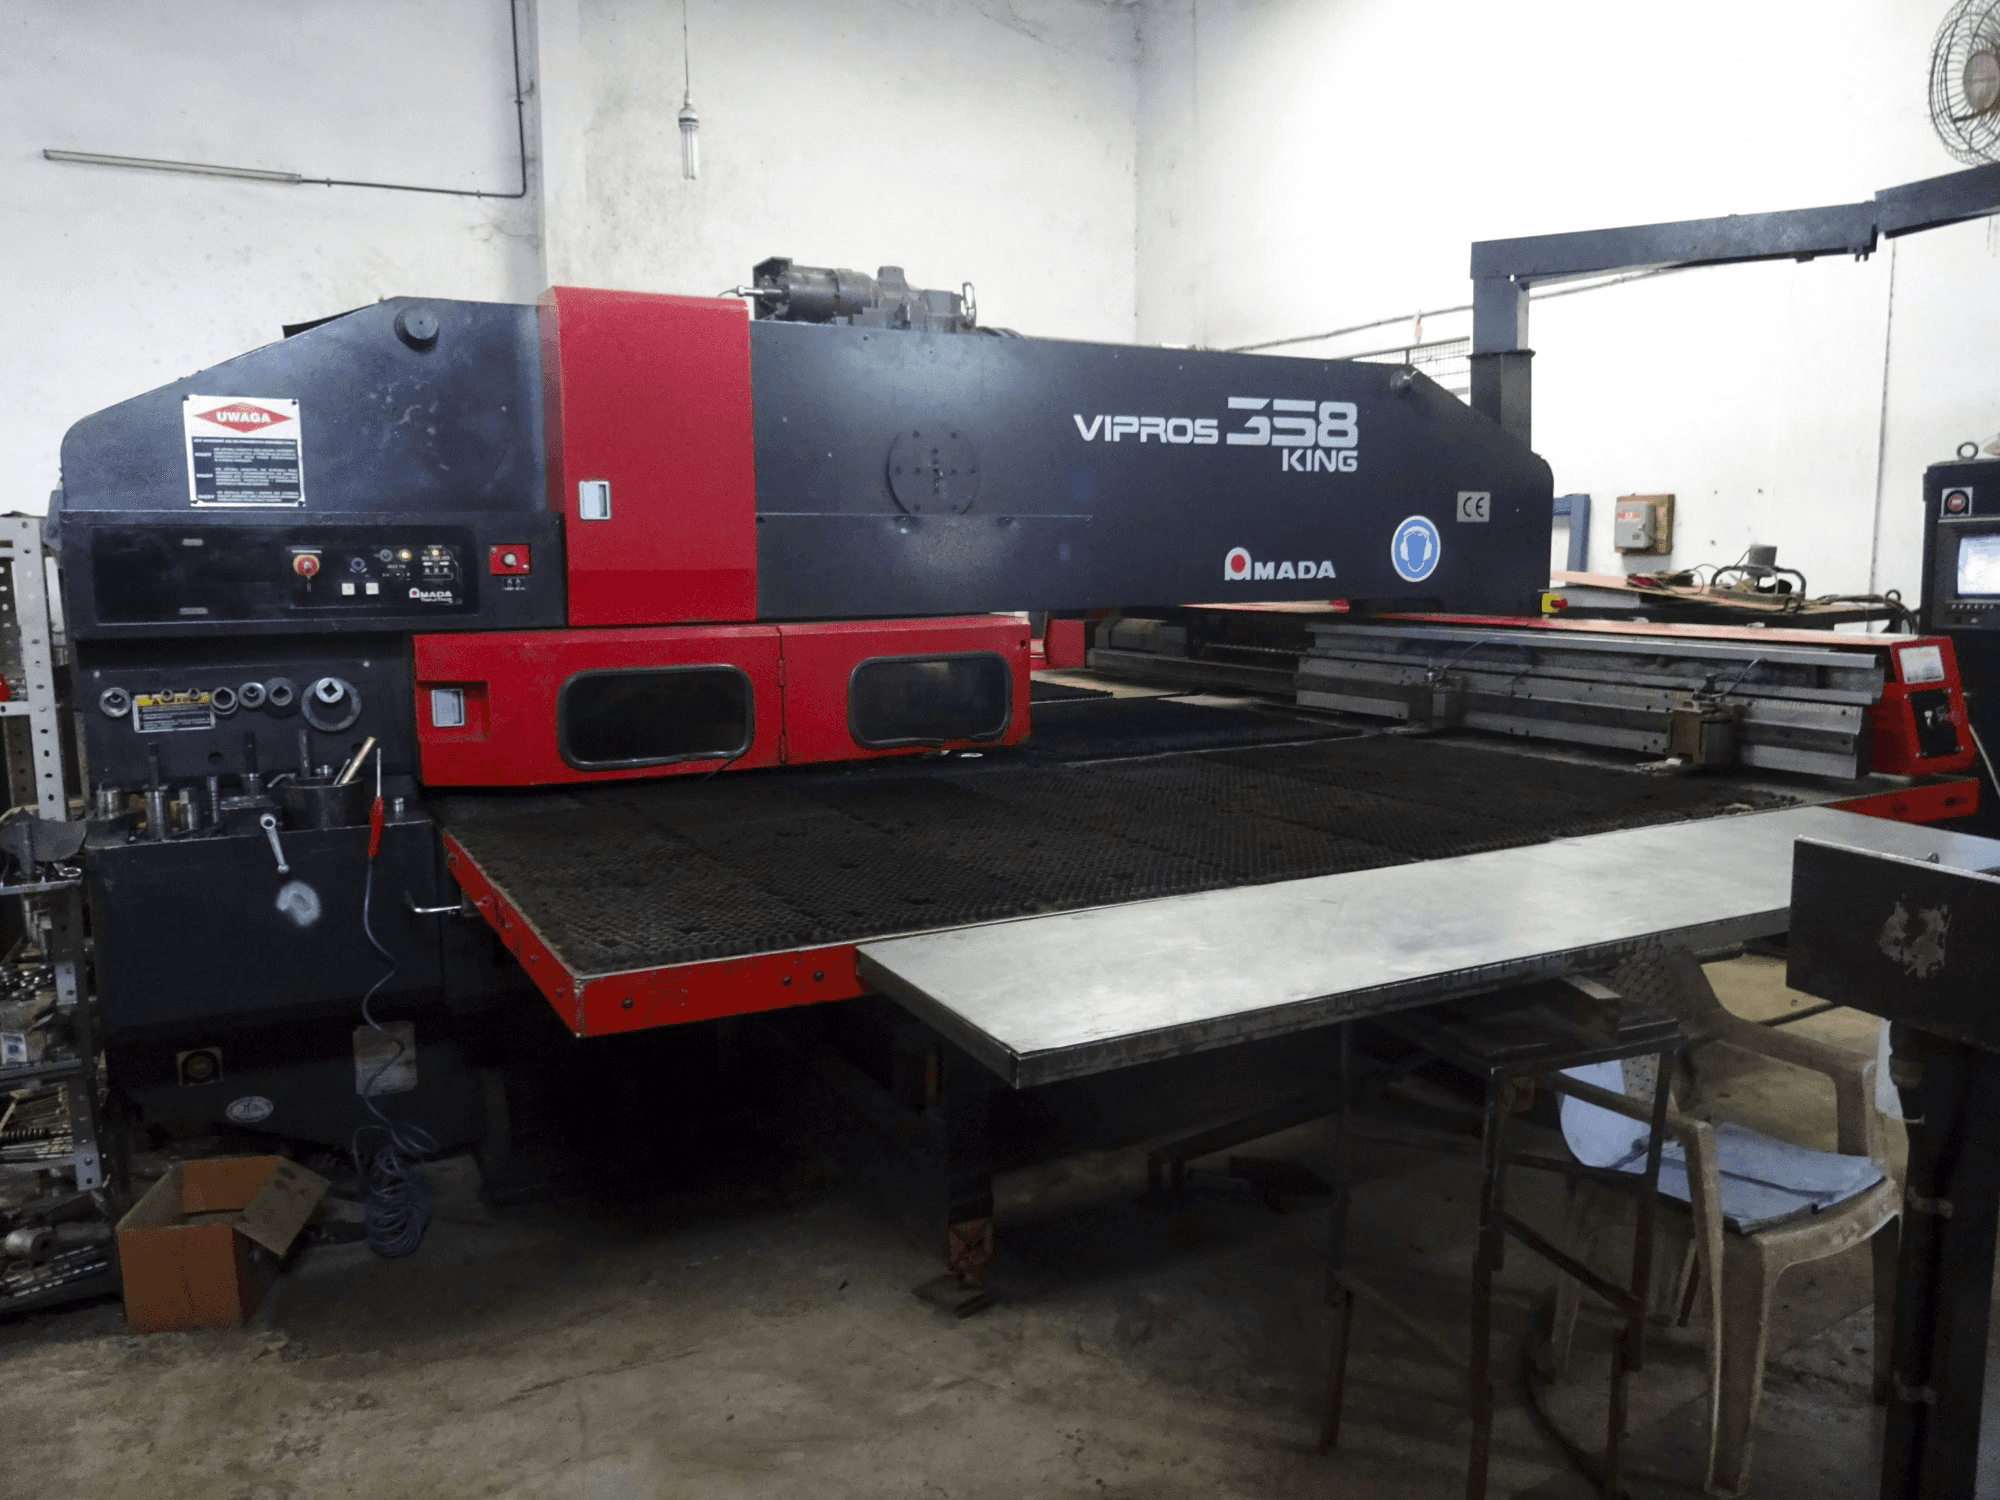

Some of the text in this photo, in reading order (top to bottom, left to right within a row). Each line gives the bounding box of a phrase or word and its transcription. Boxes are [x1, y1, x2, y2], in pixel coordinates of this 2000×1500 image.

[216, 411, 271, 423] UWAGA
[1073, 396, 1359, 448] VIPROS 358
[1282, 448, 1359, 473] KING
[1463, 496, 1485, 518] CE
[1223, 546, 1337, 581] AMADA
